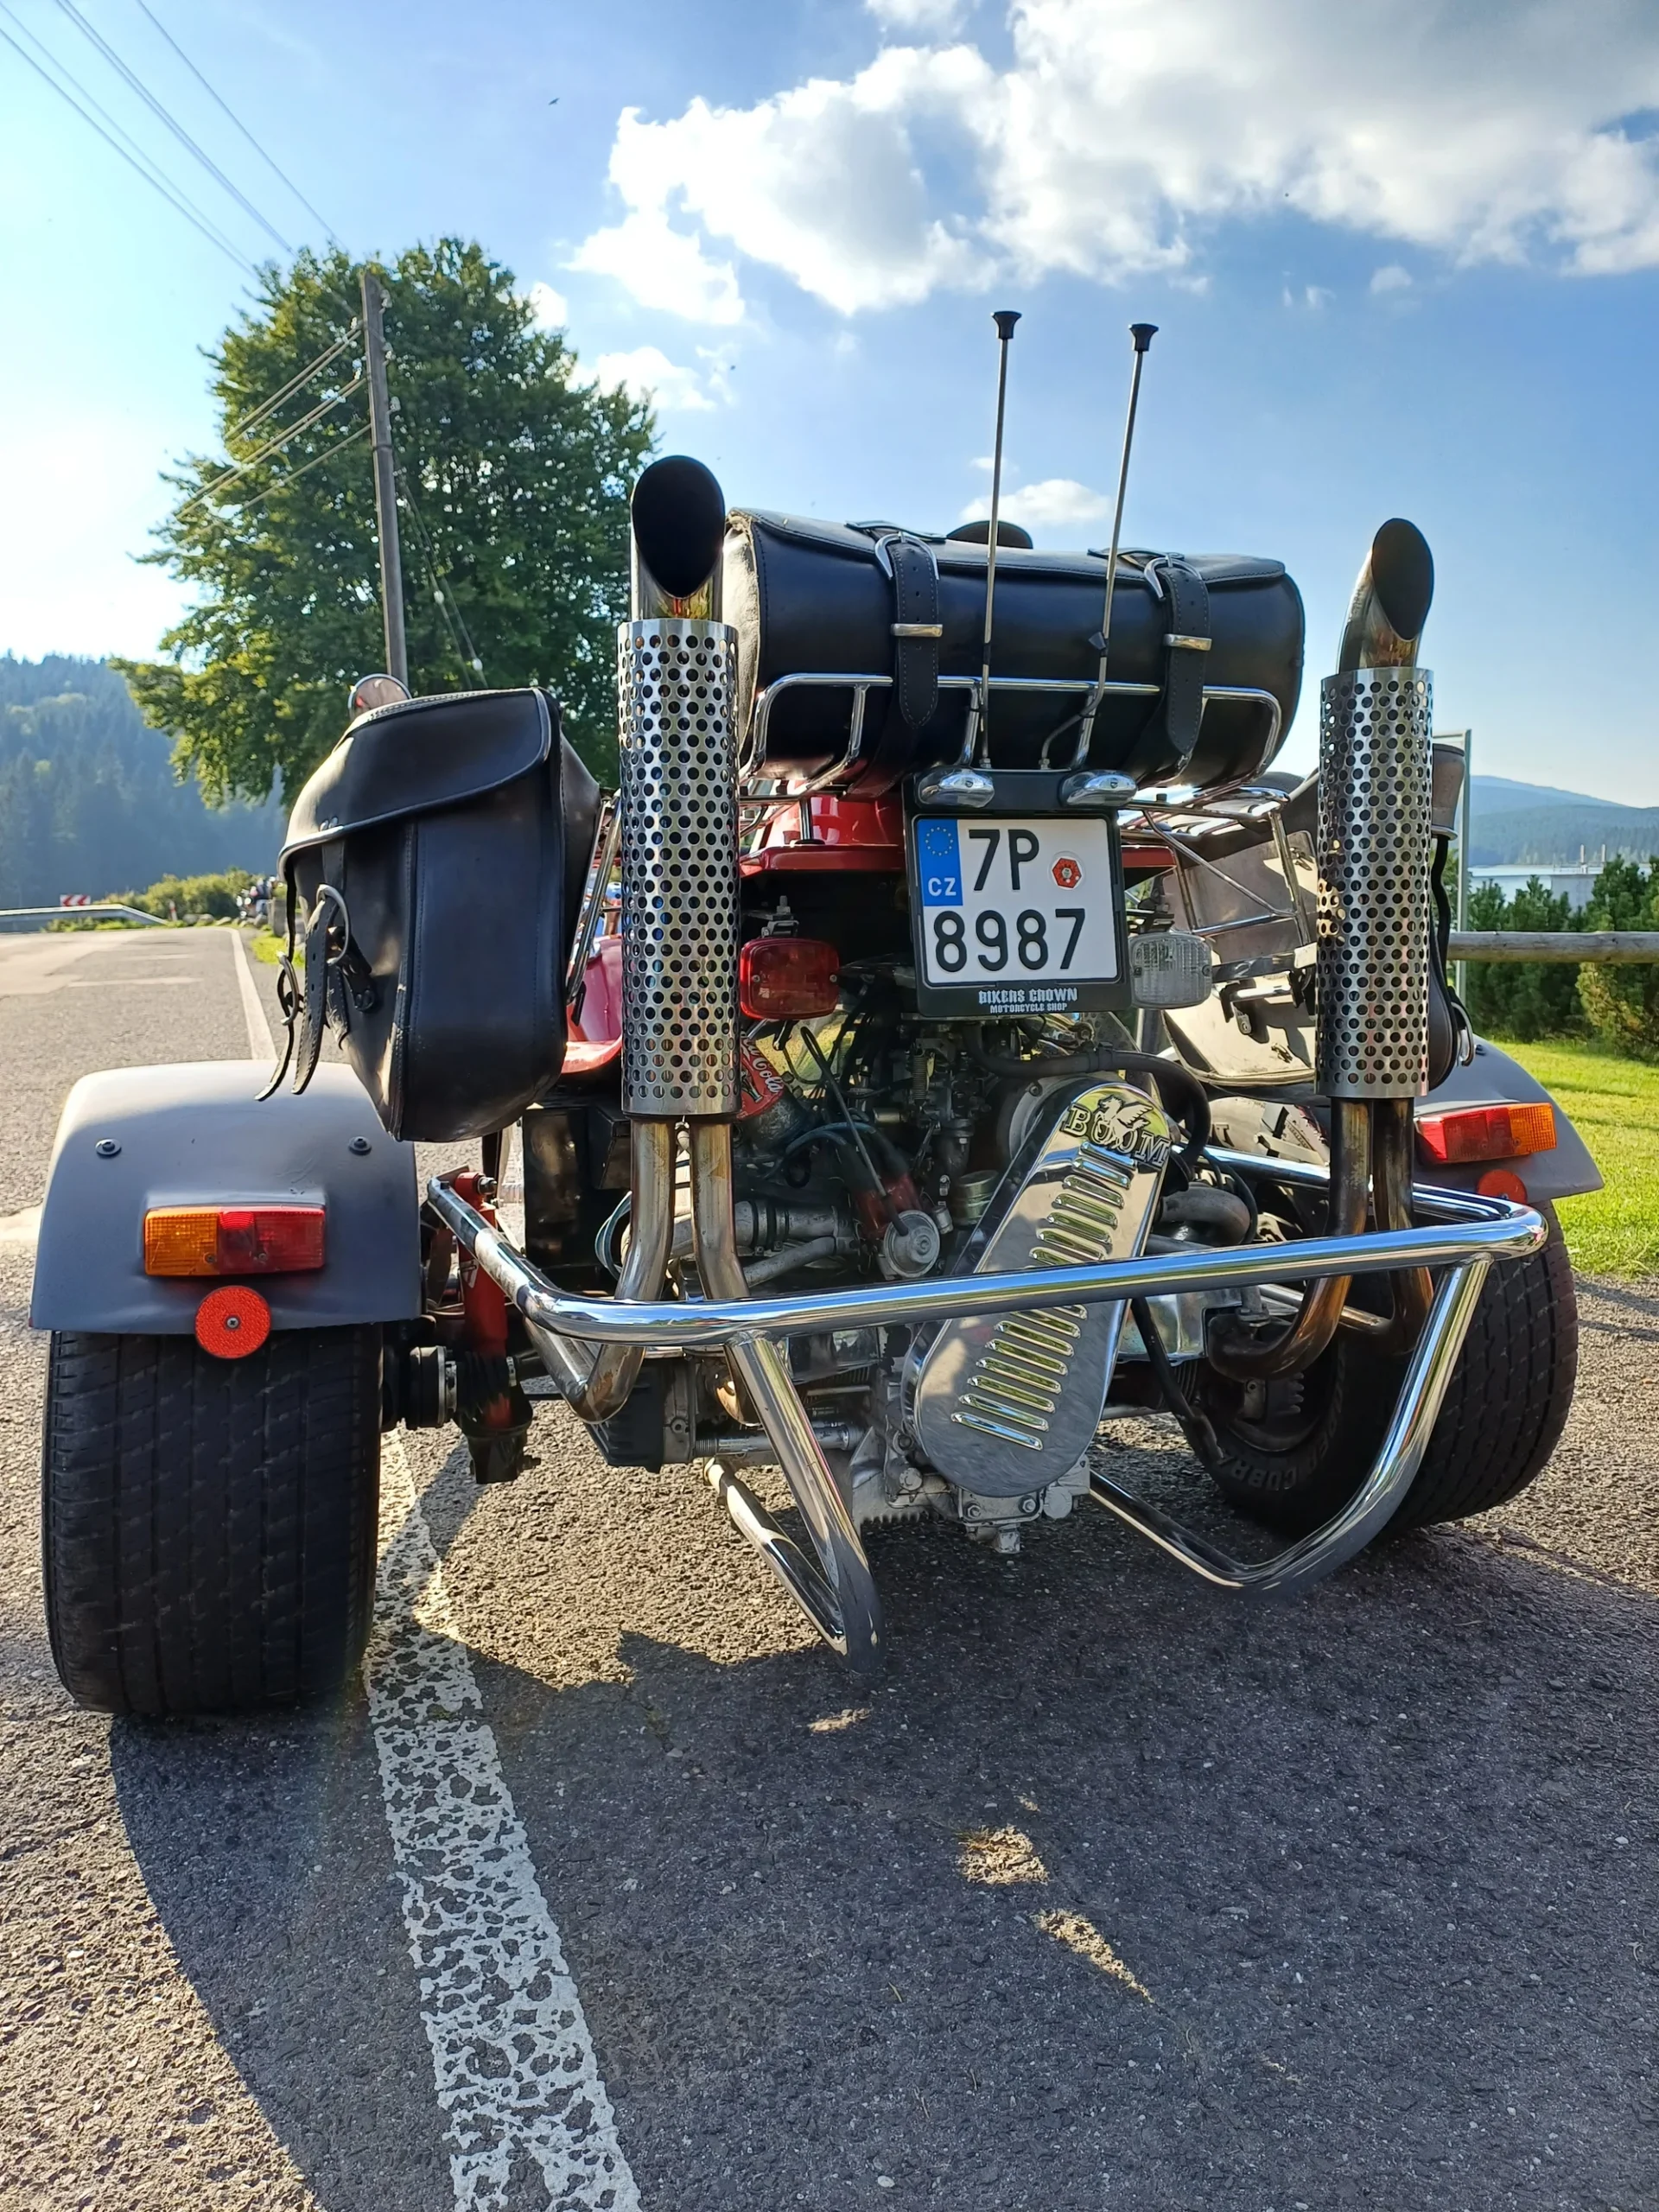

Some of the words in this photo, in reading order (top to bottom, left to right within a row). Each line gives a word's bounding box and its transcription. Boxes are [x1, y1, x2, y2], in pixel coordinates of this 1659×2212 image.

[969, 829, 1039, 891] 7P
[927, 877, 957, 896] CZ
[933, 908, 1085, 972] 8987
[978, 988, 1026, 1004] BIKERS
[1028, 988, 1077, 1002] CROWN
[989, 1003, 1045, 1014] MOTORCYCLE
[1046, 1002, 1068, 1011] SHOP
[1061, 1104, 1171, 1167] BOOM
